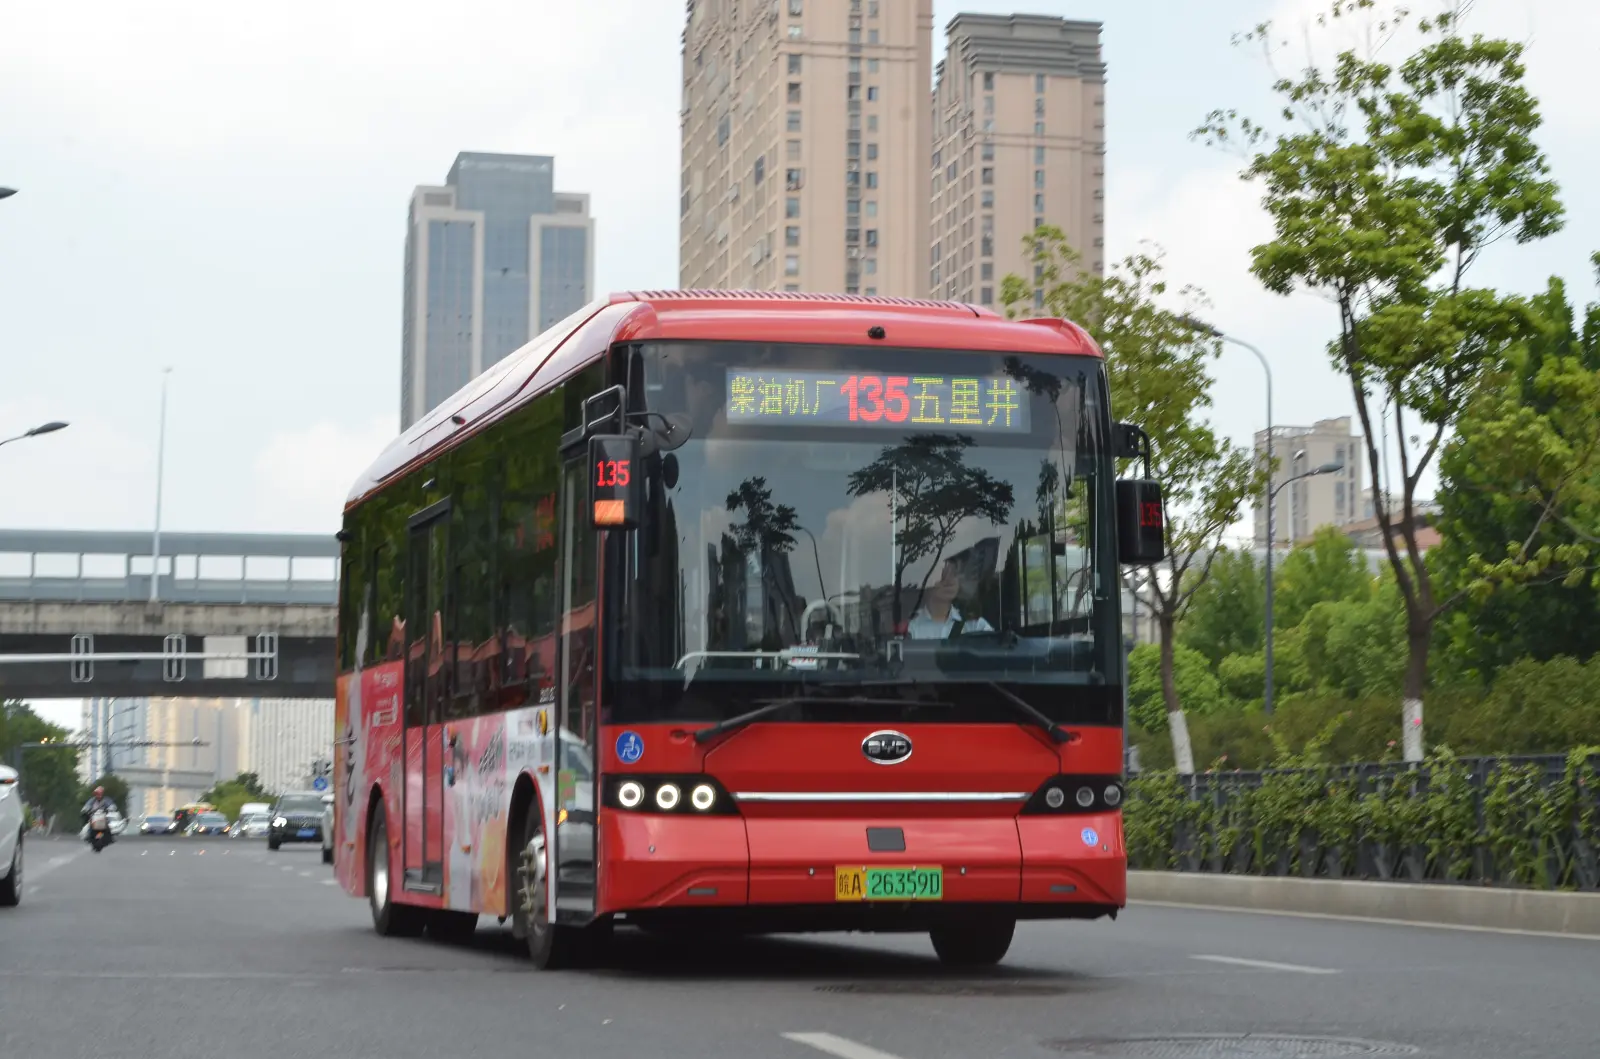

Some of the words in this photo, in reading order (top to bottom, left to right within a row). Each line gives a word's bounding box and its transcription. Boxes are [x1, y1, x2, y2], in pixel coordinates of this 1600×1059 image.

[731, 376, 836, 416] 柴油机厂
[840, 375, 910, 422] 135
[911, 376, 1019, 427] 五里井
[596, 460, 631, 487] 135
[868, 740, 908, 755] BYD
